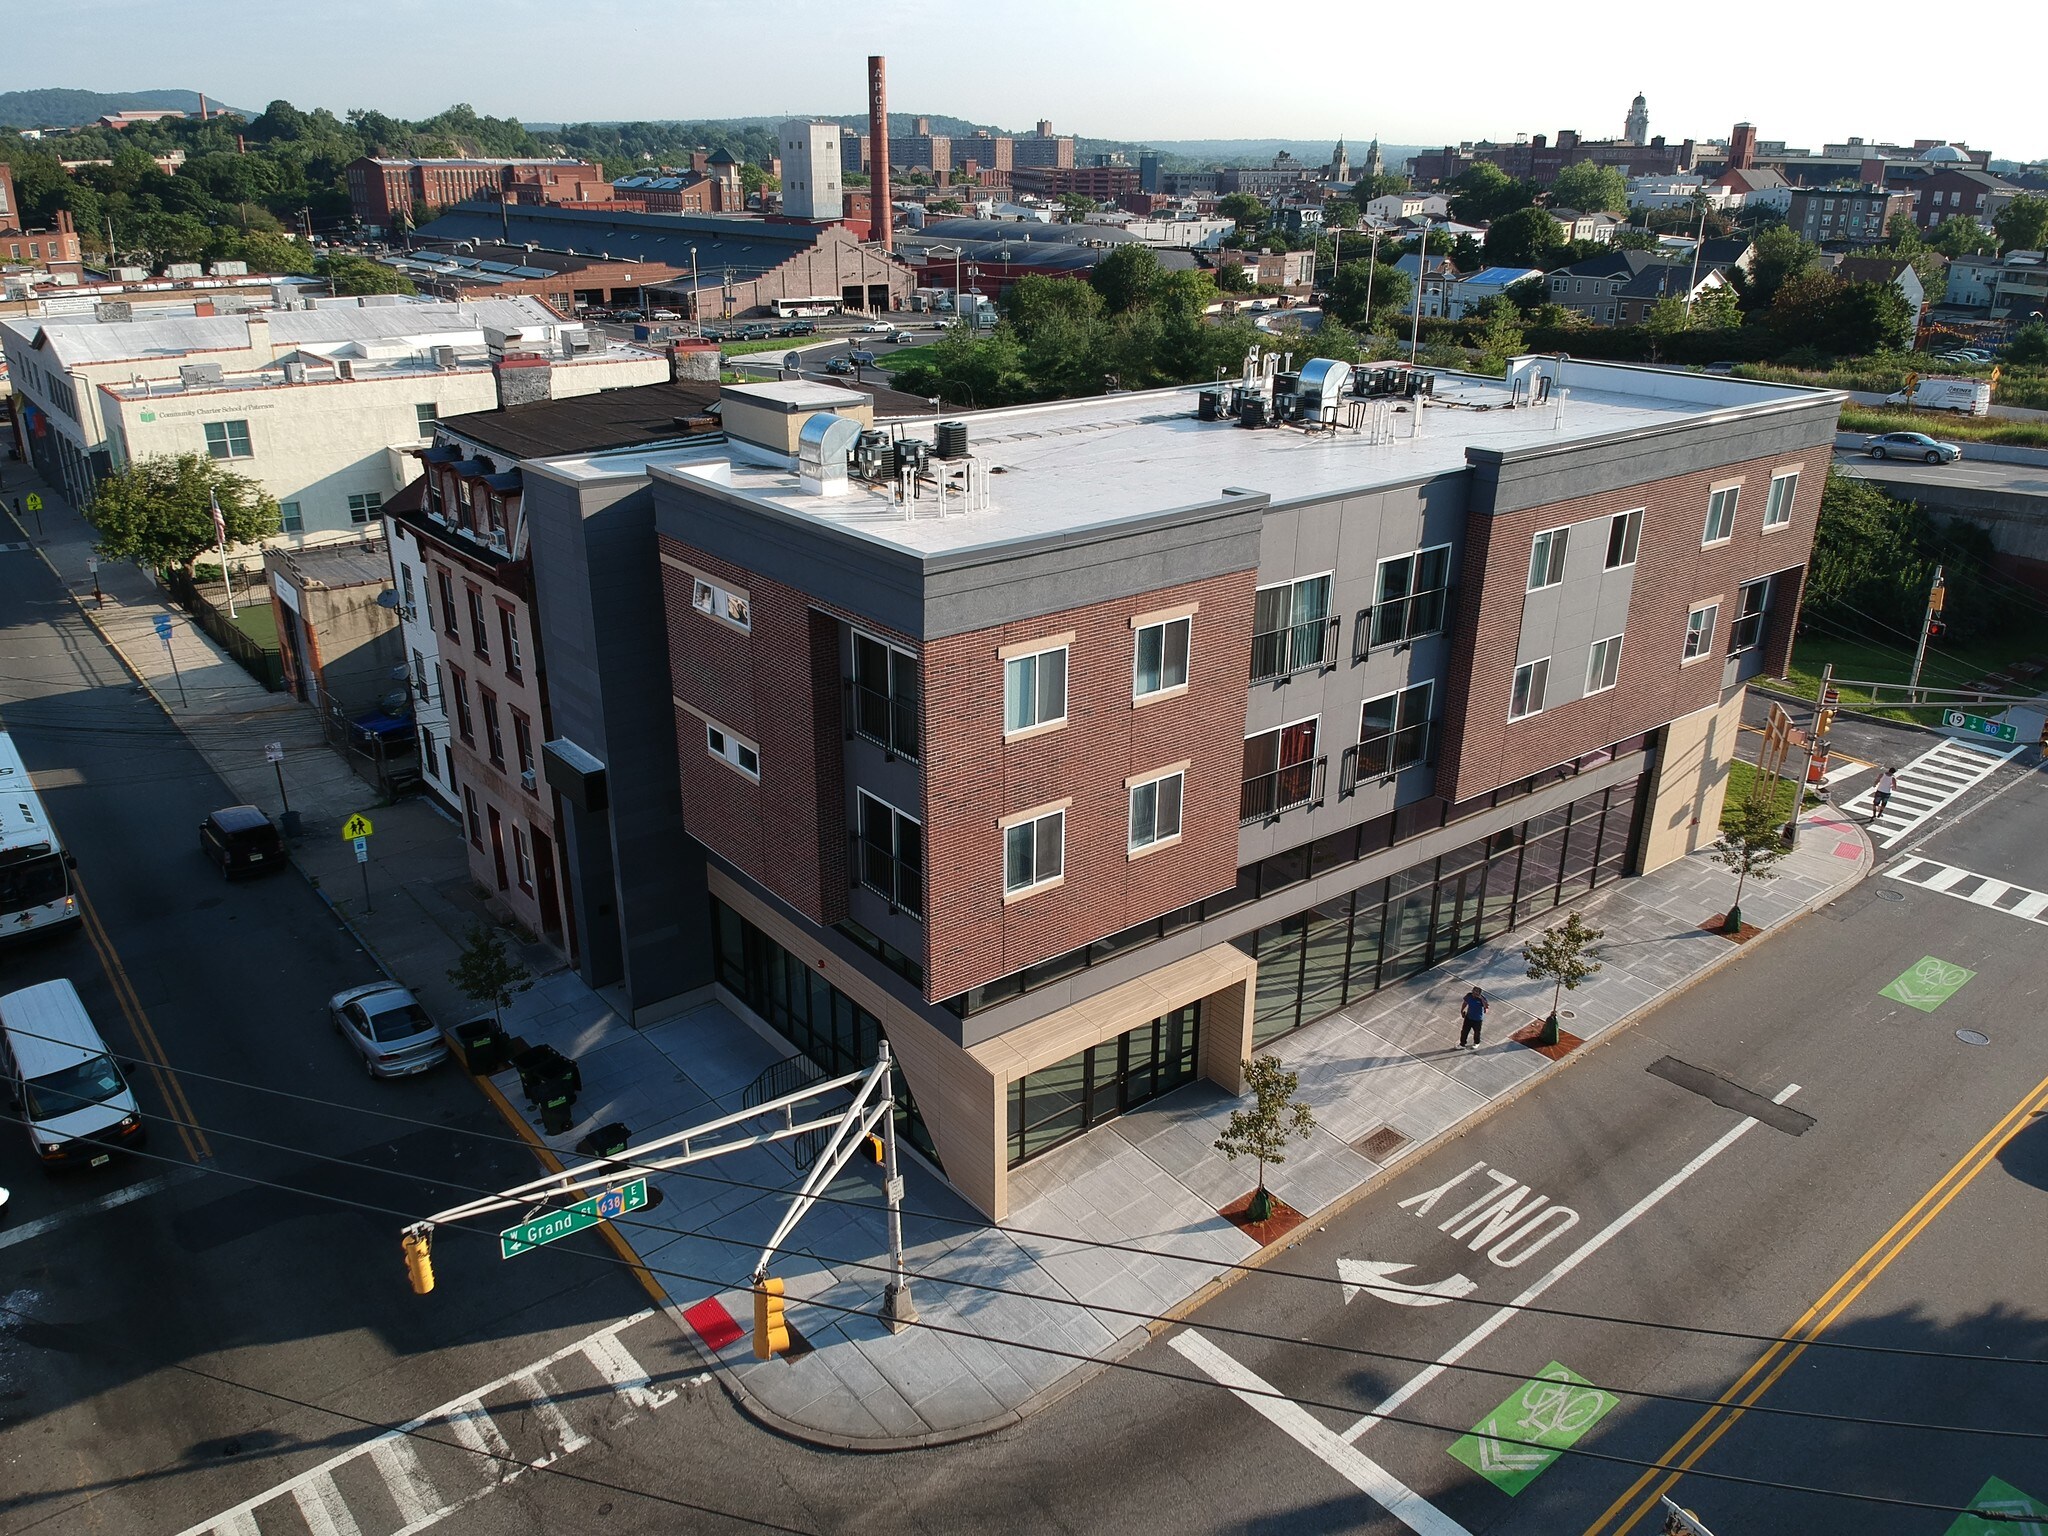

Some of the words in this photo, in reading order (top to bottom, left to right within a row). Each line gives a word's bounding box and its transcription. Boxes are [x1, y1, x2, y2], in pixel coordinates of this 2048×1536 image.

[159, 410, 195, 419] Community
[1952, 715, 1963, 724] 19
[1985, 725, 1997, 734] 80
[510, 1230, 518, 1240] W
[527, 1214, 572, 1242] Grand
[581, 1206, 591, 1217] St
[601, 1196, 621, 1213] 638
[631, 1185, 637, 1196] E
[1397, 1160, 1580, 1268] ONLY
